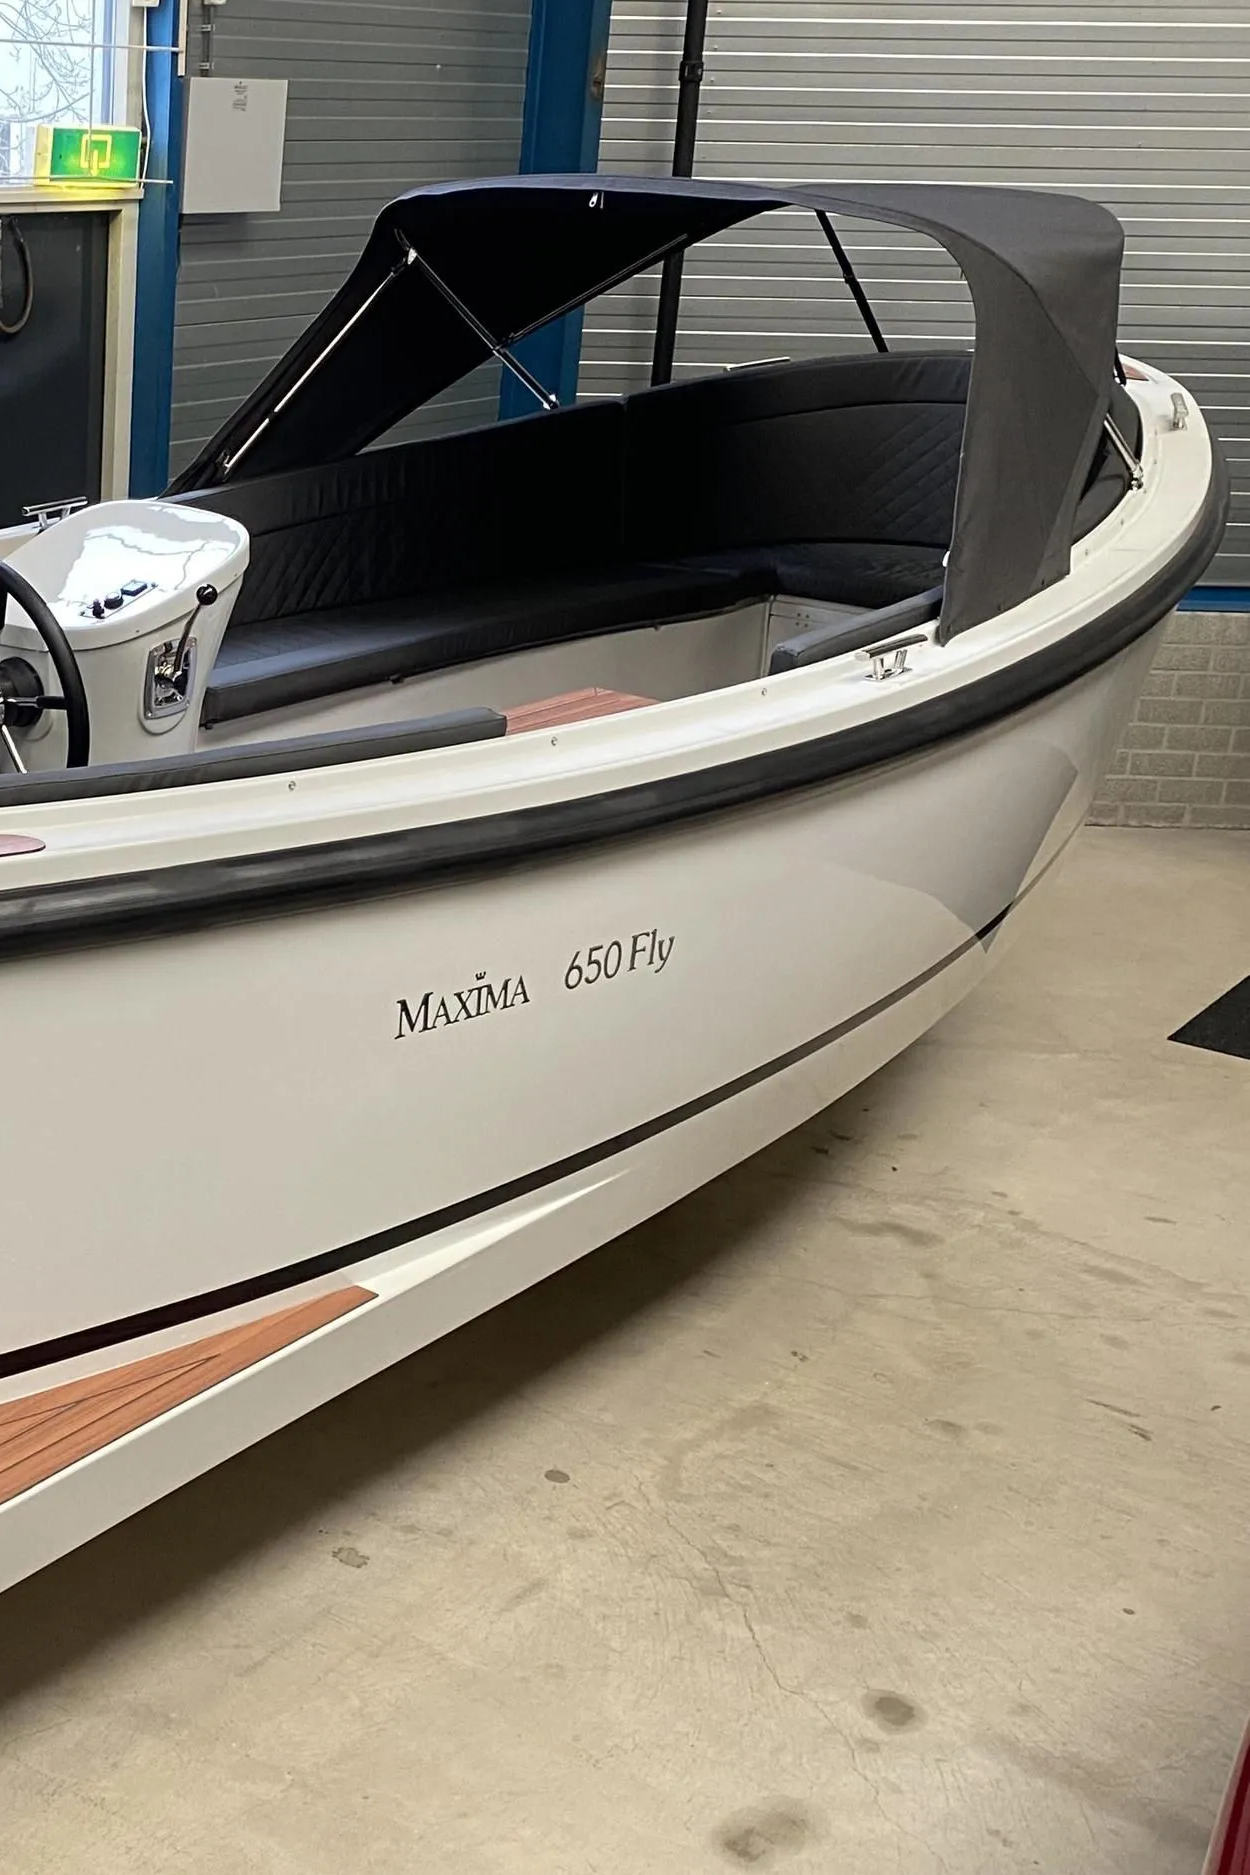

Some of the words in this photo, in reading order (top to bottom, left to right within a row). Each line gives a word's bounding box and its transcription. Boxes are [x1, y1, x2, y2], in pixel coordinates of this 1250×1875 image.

[394, 972, 530, 1040] MAXIMA
[564, 940, 622, 990] 650
[627, 928, 675, 974] Fly
